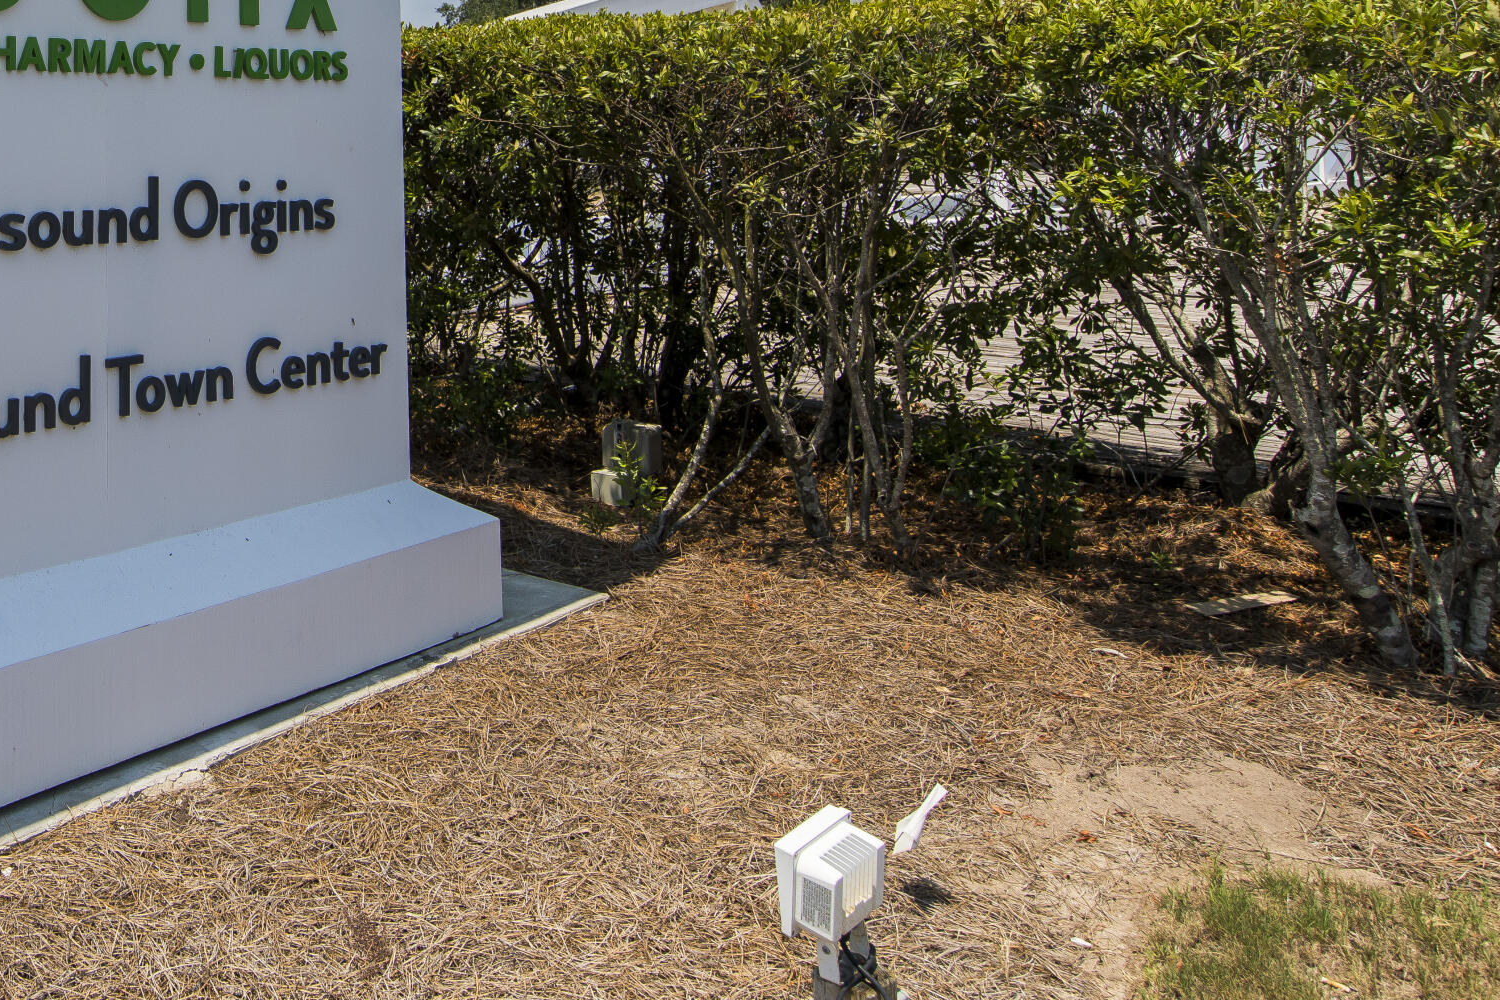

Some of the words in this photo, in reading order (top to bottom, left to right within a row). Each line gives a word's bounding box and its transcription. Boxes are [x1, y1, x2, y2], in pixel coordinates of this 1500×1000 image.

[213, 45, 349, 83] LIQUORS
[172, 177, 336, 257] Origins
[104, 351, 235, 418] Town
[244, 335, 388, 398] Center
